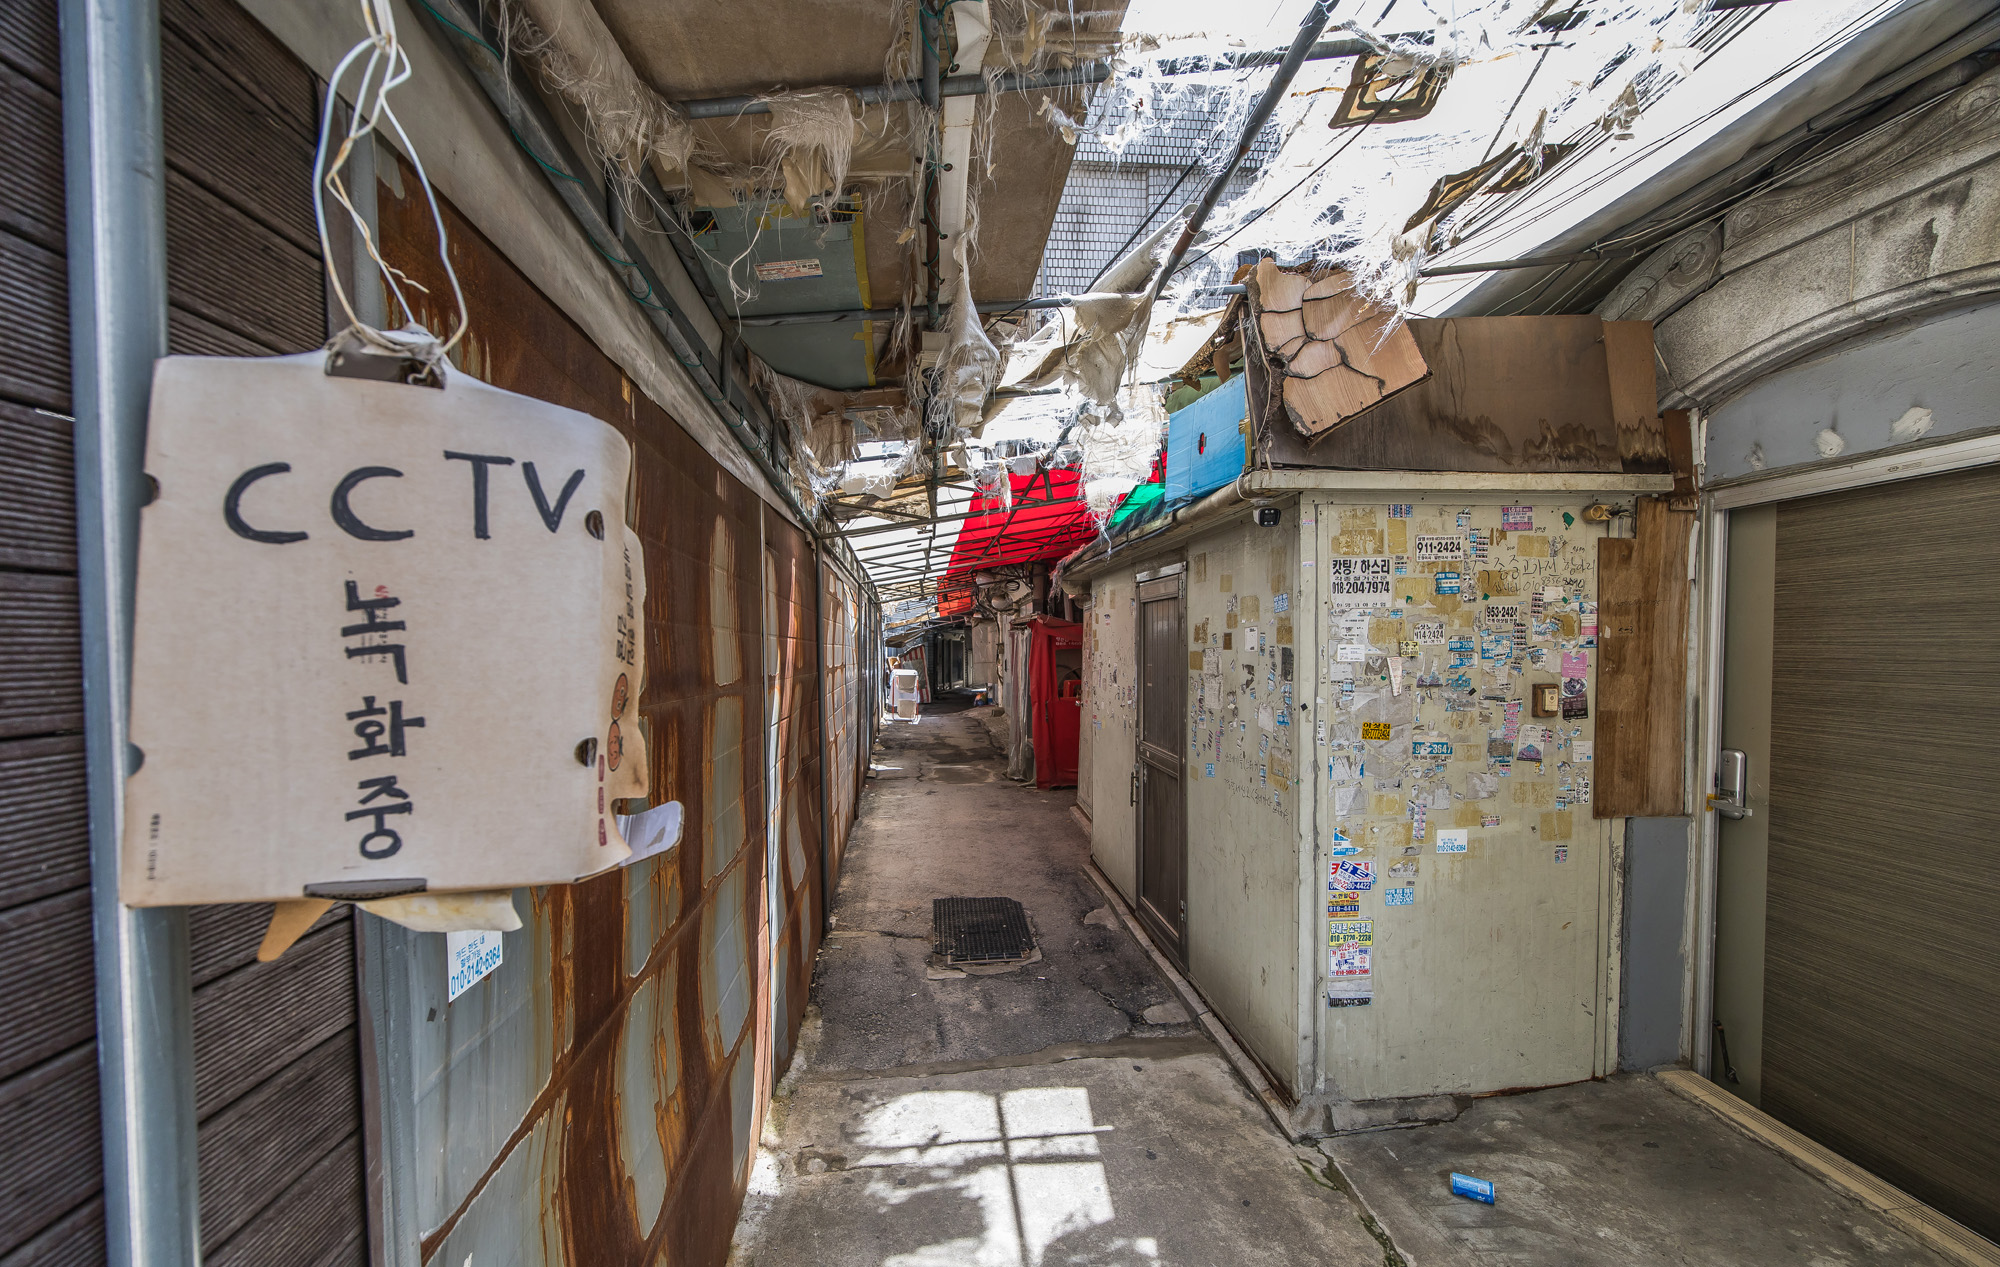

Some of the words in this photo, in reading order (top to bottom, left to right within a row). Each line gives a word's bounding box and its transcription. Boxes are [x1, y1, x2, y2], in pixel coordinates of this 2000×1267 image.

[223, 449, 585, 544] CCTV
[1361, 559, 1390, 574] 하스리
[341, 578, 425, 860] 녹화중
[450, 943, 501, 996] 010-2142-6364
